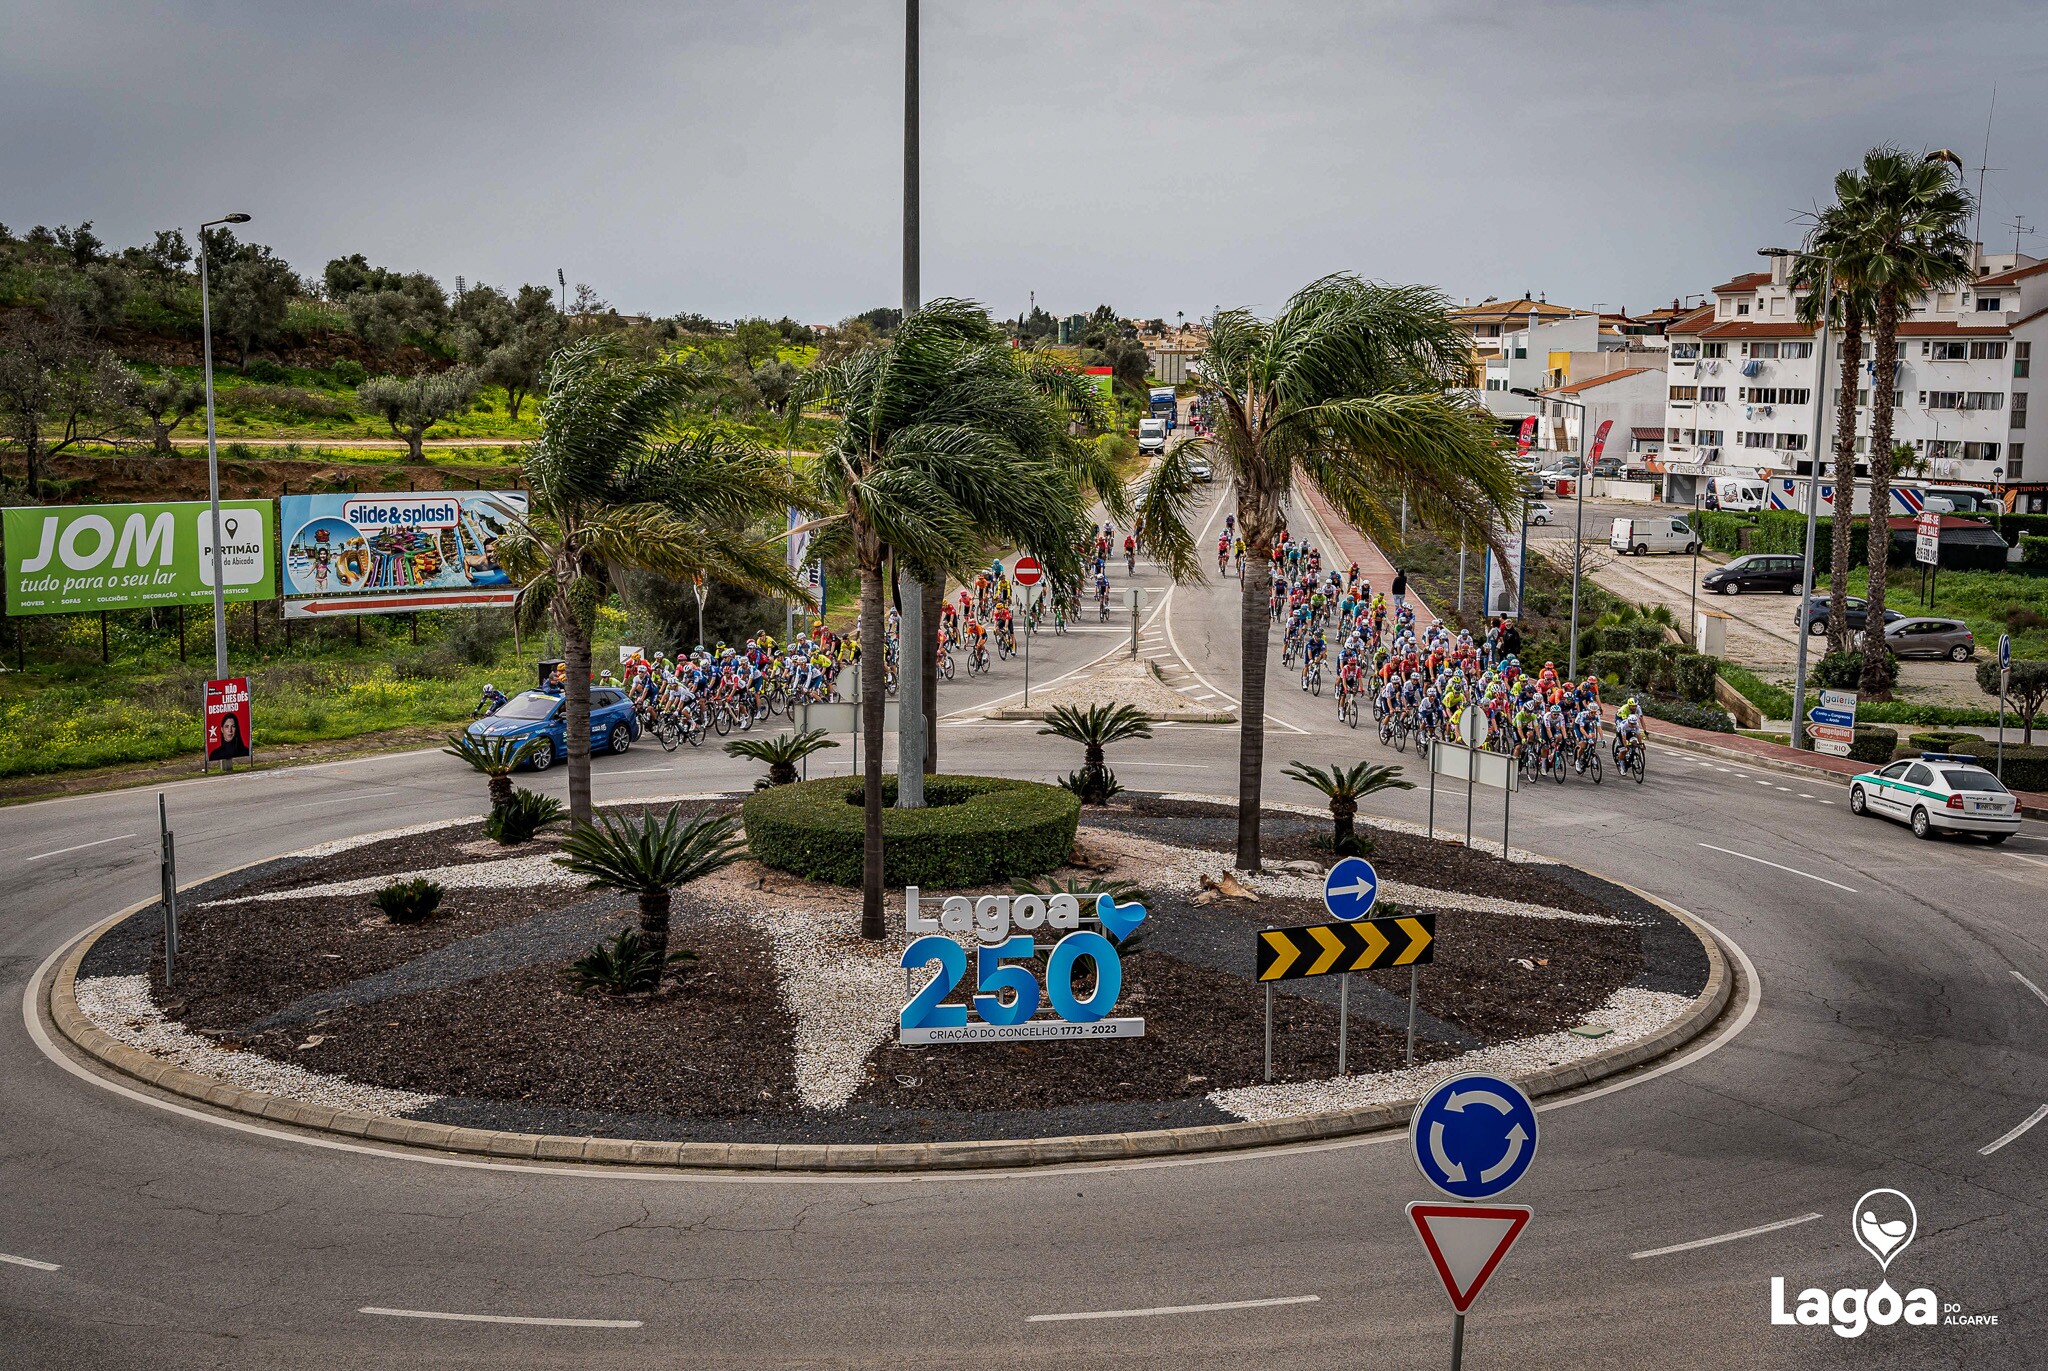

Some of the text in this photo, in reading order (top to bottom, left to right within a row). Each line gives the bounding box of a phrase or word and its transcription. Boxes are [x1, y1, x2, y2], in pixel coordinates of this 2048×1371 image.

[350, 504, 454, 526] slide&splash
[1918, 524, 1938, 536] FOR SALE
[20, 512, 175, 573] JOM
[204, 543, 260, 556] PRTIMÃO
[20, 568, 177, 596] tudo para o seu lar
[222, 691, 248, 704] LHES DÊS
[225, 684, 237, 694] NÃO
[208, 703, 238, 714] DESCANSO
[905, 886, 1079, 942] Lagoa
[900, 931, 1122, 1028] 250
[929, 1026, 977, 1042] CRIAÇÃO
[980, 1027, 998, 1039] DO
[999, 1026, 1058, 1039] CONCELHO
[1060, 1026, 1083, 1037] 1773
[1091, 1025, 1117, 1035] 2023
